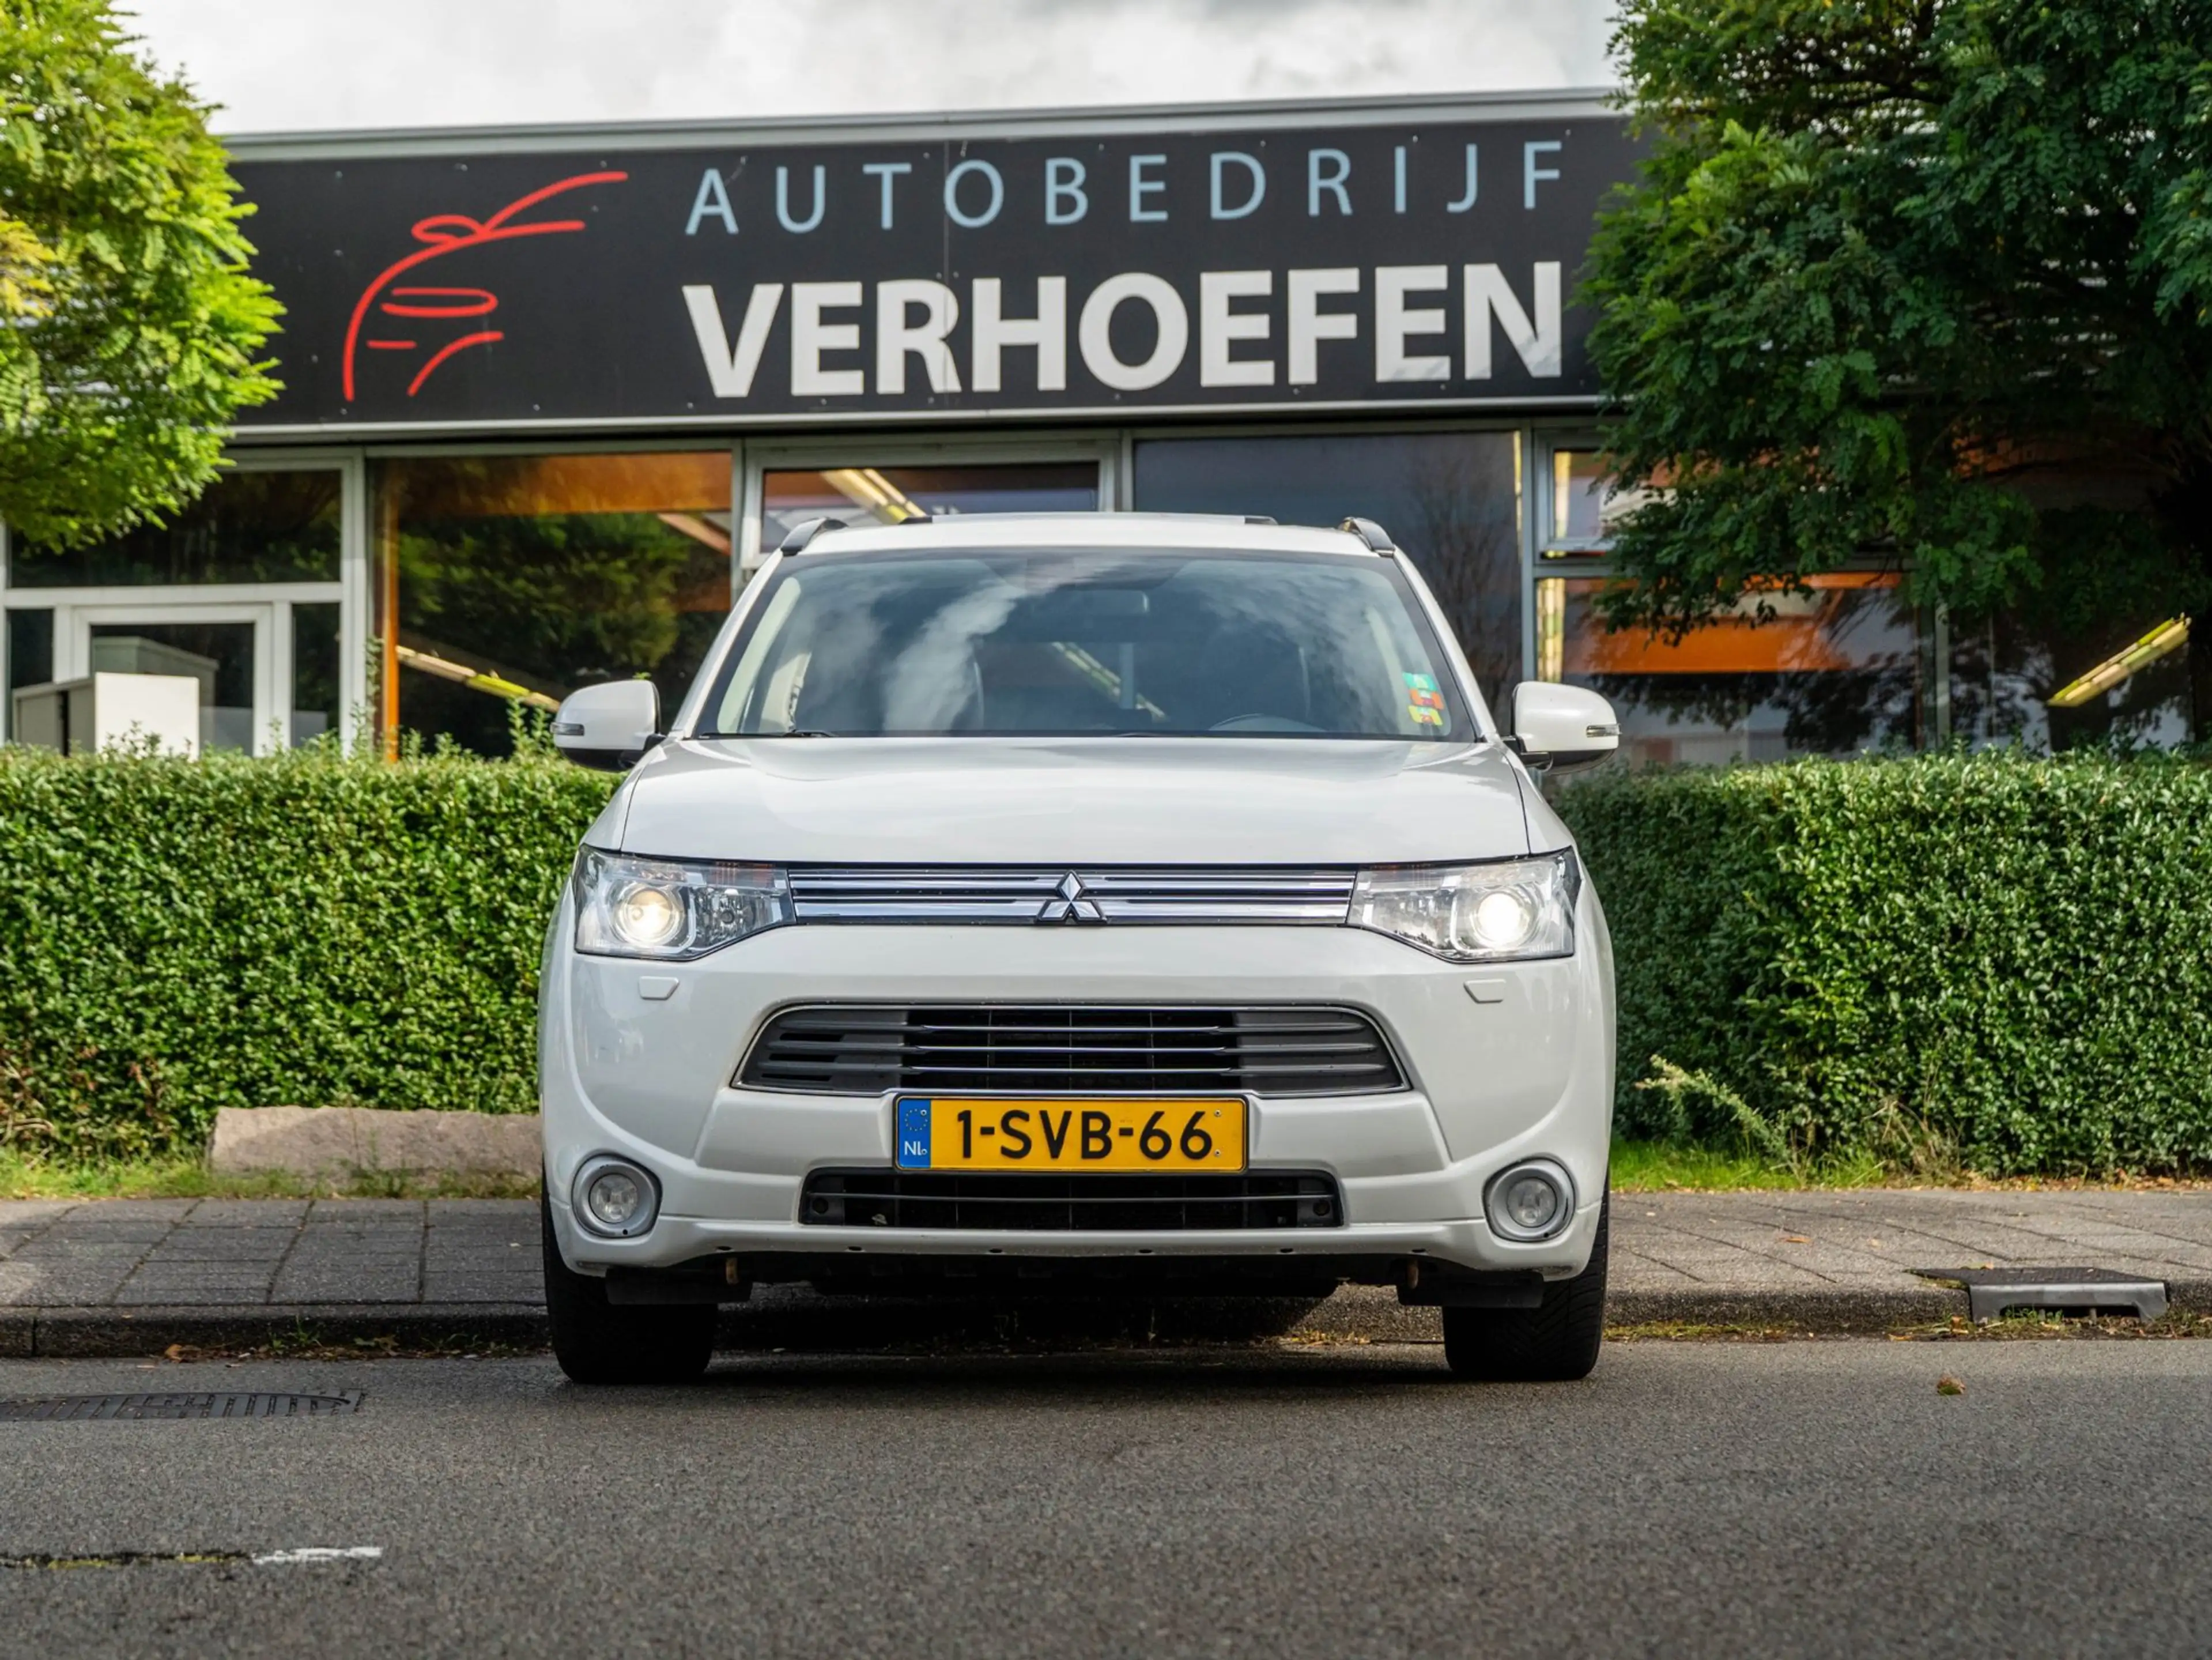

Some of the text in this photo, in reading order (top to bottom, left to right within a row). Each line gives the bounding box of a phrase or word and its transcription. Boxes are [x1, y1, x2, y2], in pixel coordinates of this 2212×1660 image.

[685, 140, 1562, 235] AUTOBEDRIJF
[681, 261, 1562, 398] VERHOEFEN
[904, 1141, 924, 1156] NL
[957, 1110, 1213, 1160] 1-SVB-66
